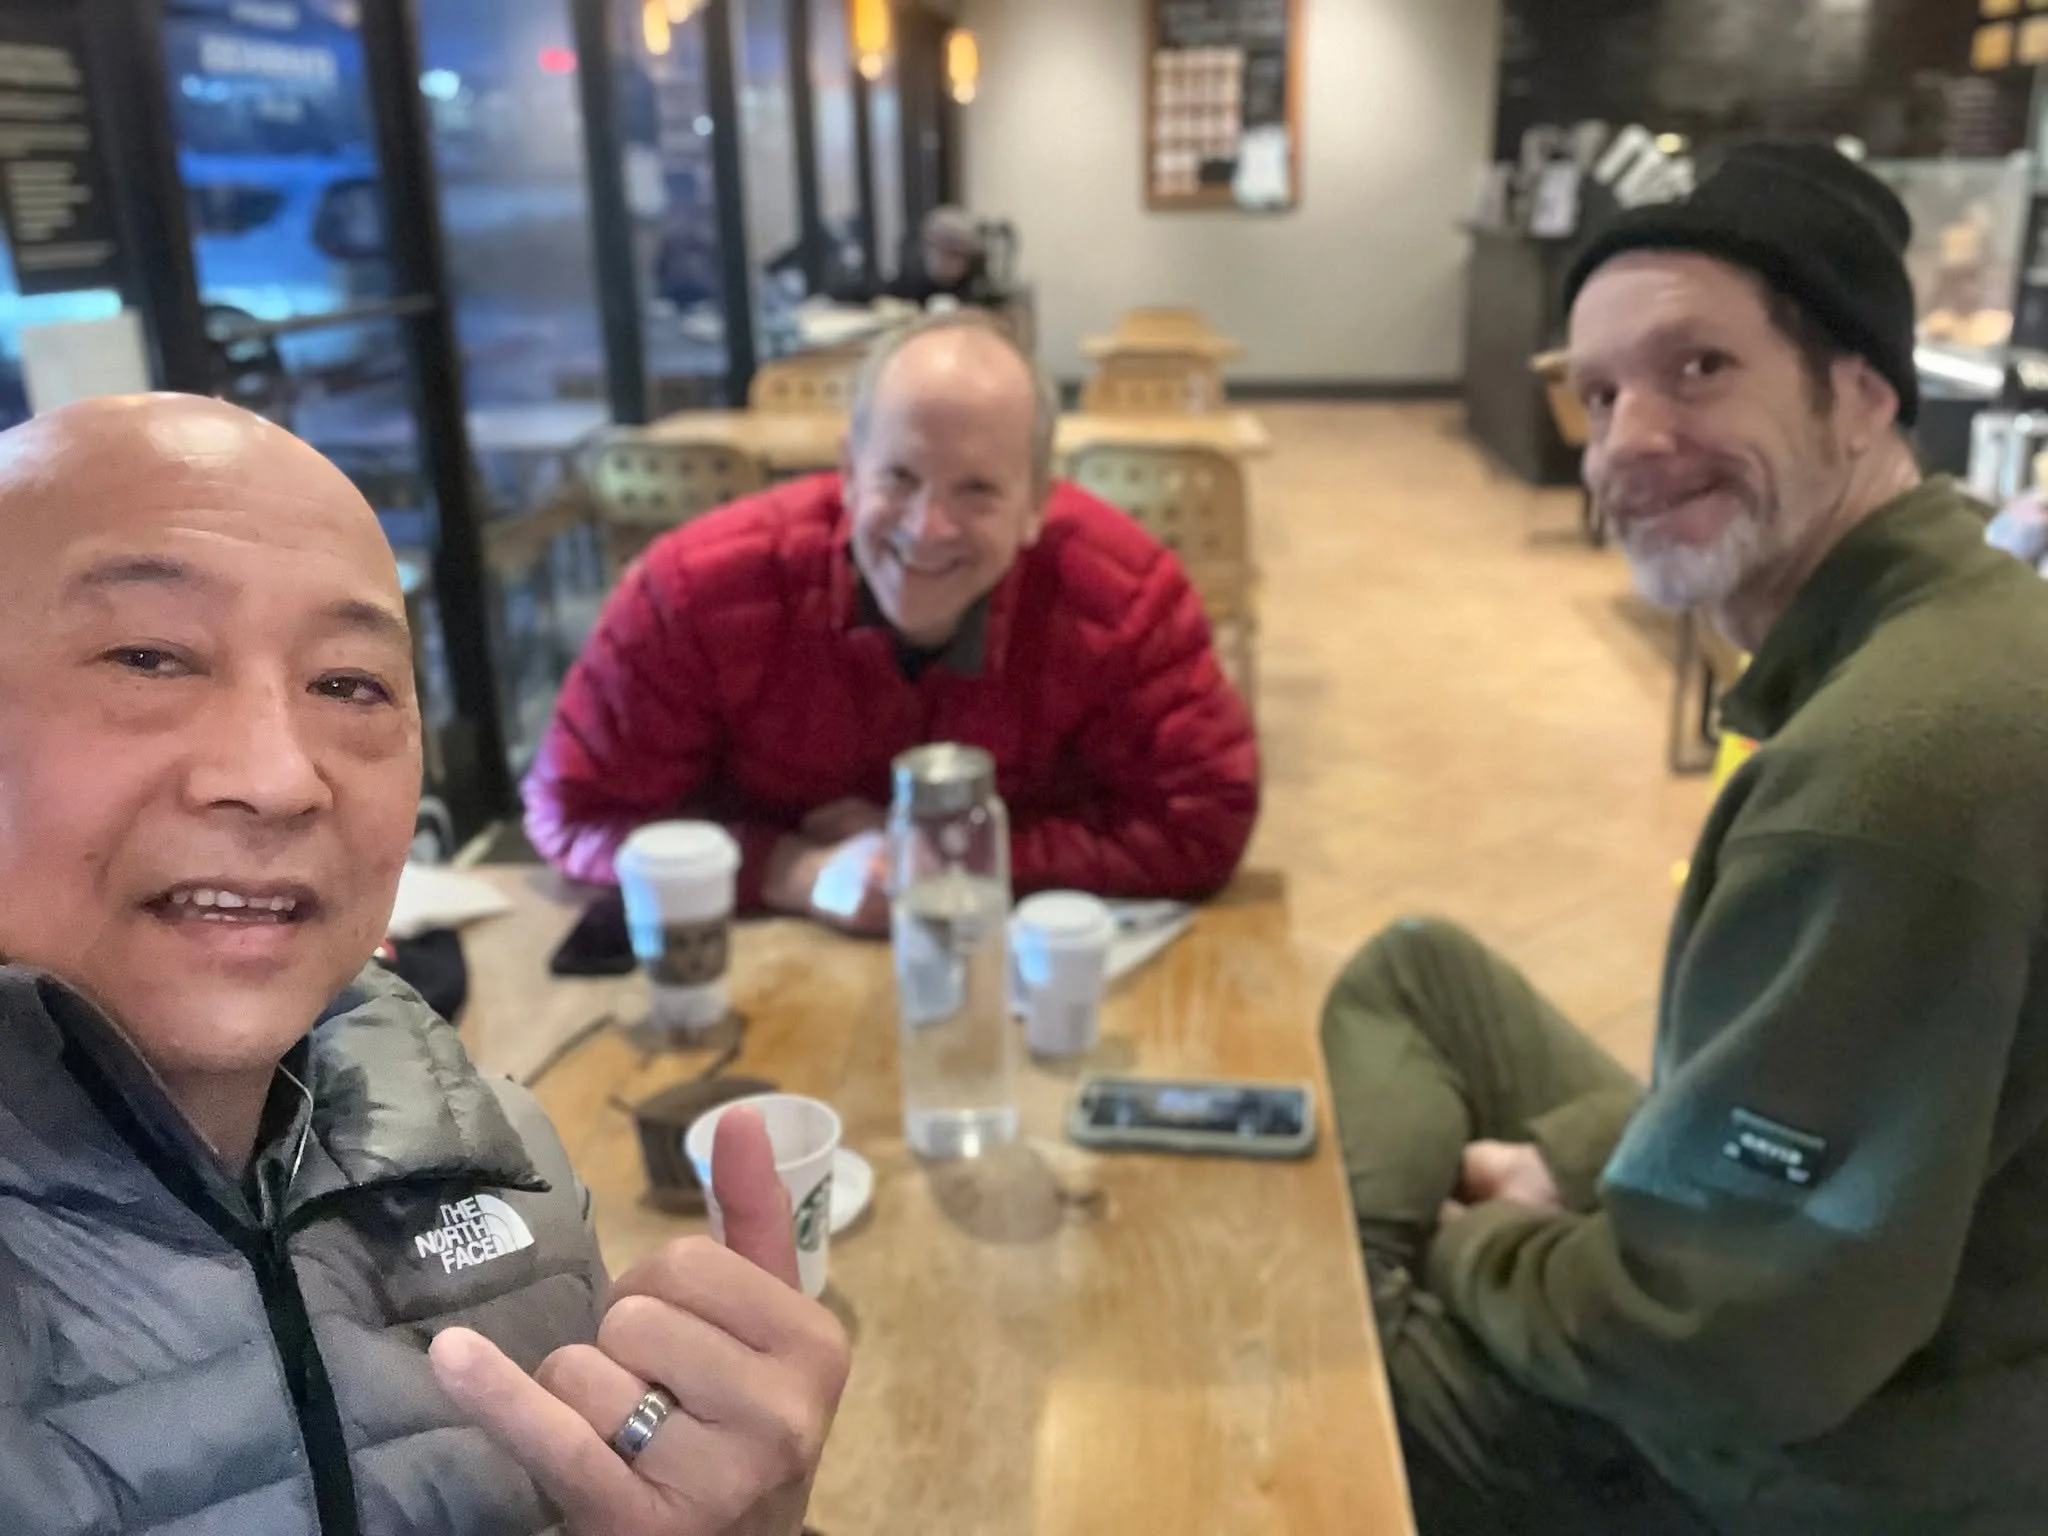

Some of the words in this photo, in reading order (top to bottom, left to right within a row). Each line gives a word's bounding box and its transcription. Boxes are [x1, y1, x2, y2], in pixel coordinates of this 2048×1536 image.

[440, 1196, 482, 1226] THE
[414, 1215, 491, 1258] NORTH
[440, 1237, 498, 1274] FACE
